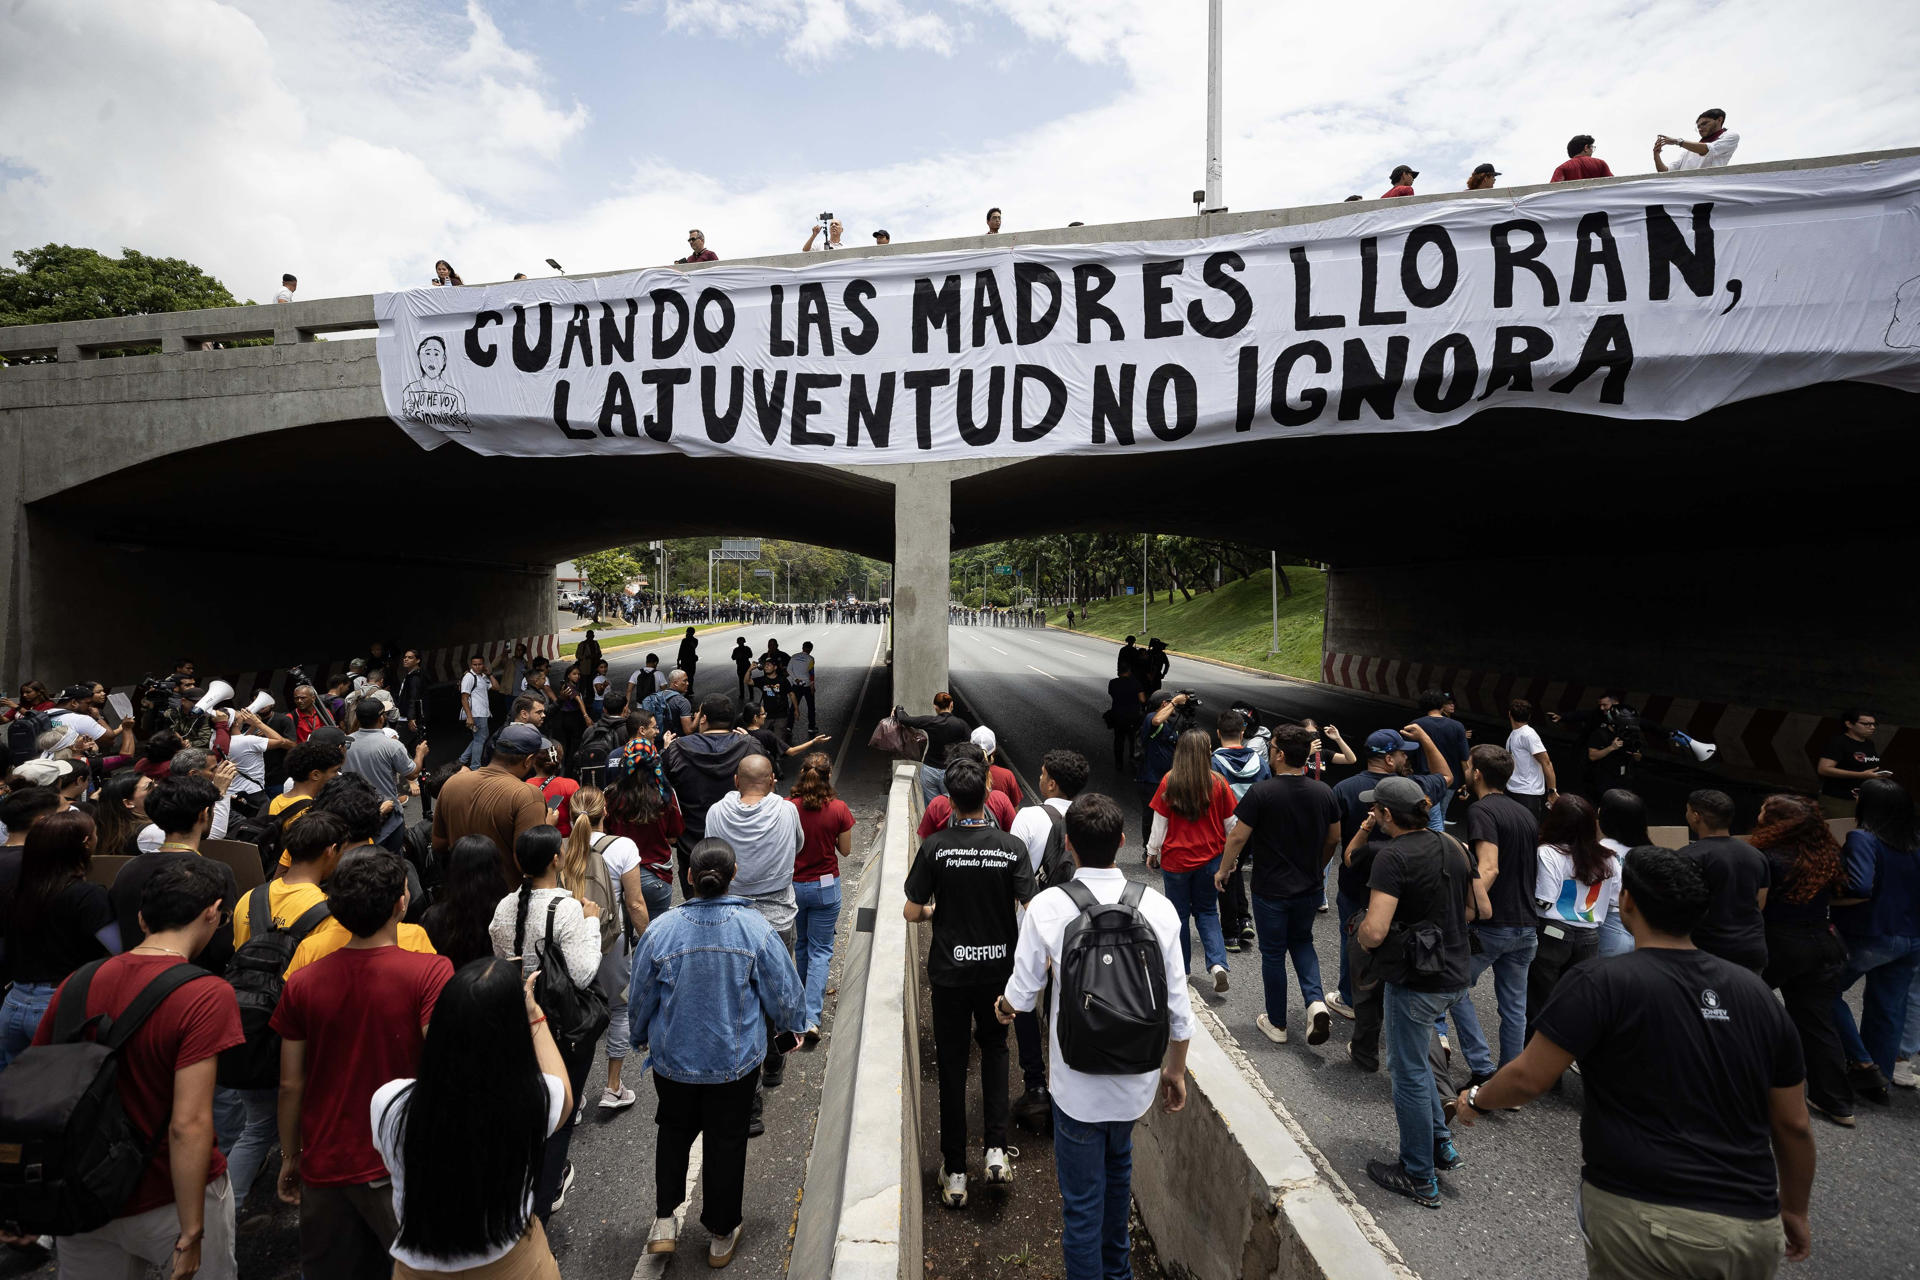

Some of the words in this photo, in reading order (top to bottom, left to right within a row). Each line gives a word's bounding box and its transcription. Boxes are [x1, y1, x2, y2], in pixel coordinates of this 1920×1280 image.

[464, 286, 735, 373] CUANDO
[769, 279, 879, 357] LAS
[911, 251, 1253, 354] MADRES
[1289, 202, 1743, 332] LLORAN,
[1091, 362, 1198, 447] NO
[1234, 313, 1634, 433] IGNORA
[935, 847, 978, 861] ¡Generando
[979, 848, 1018, 861] conciencia
[945, 857, 980, 868] forjando
[953, 943, 1007, 961] @CEFFUCV
